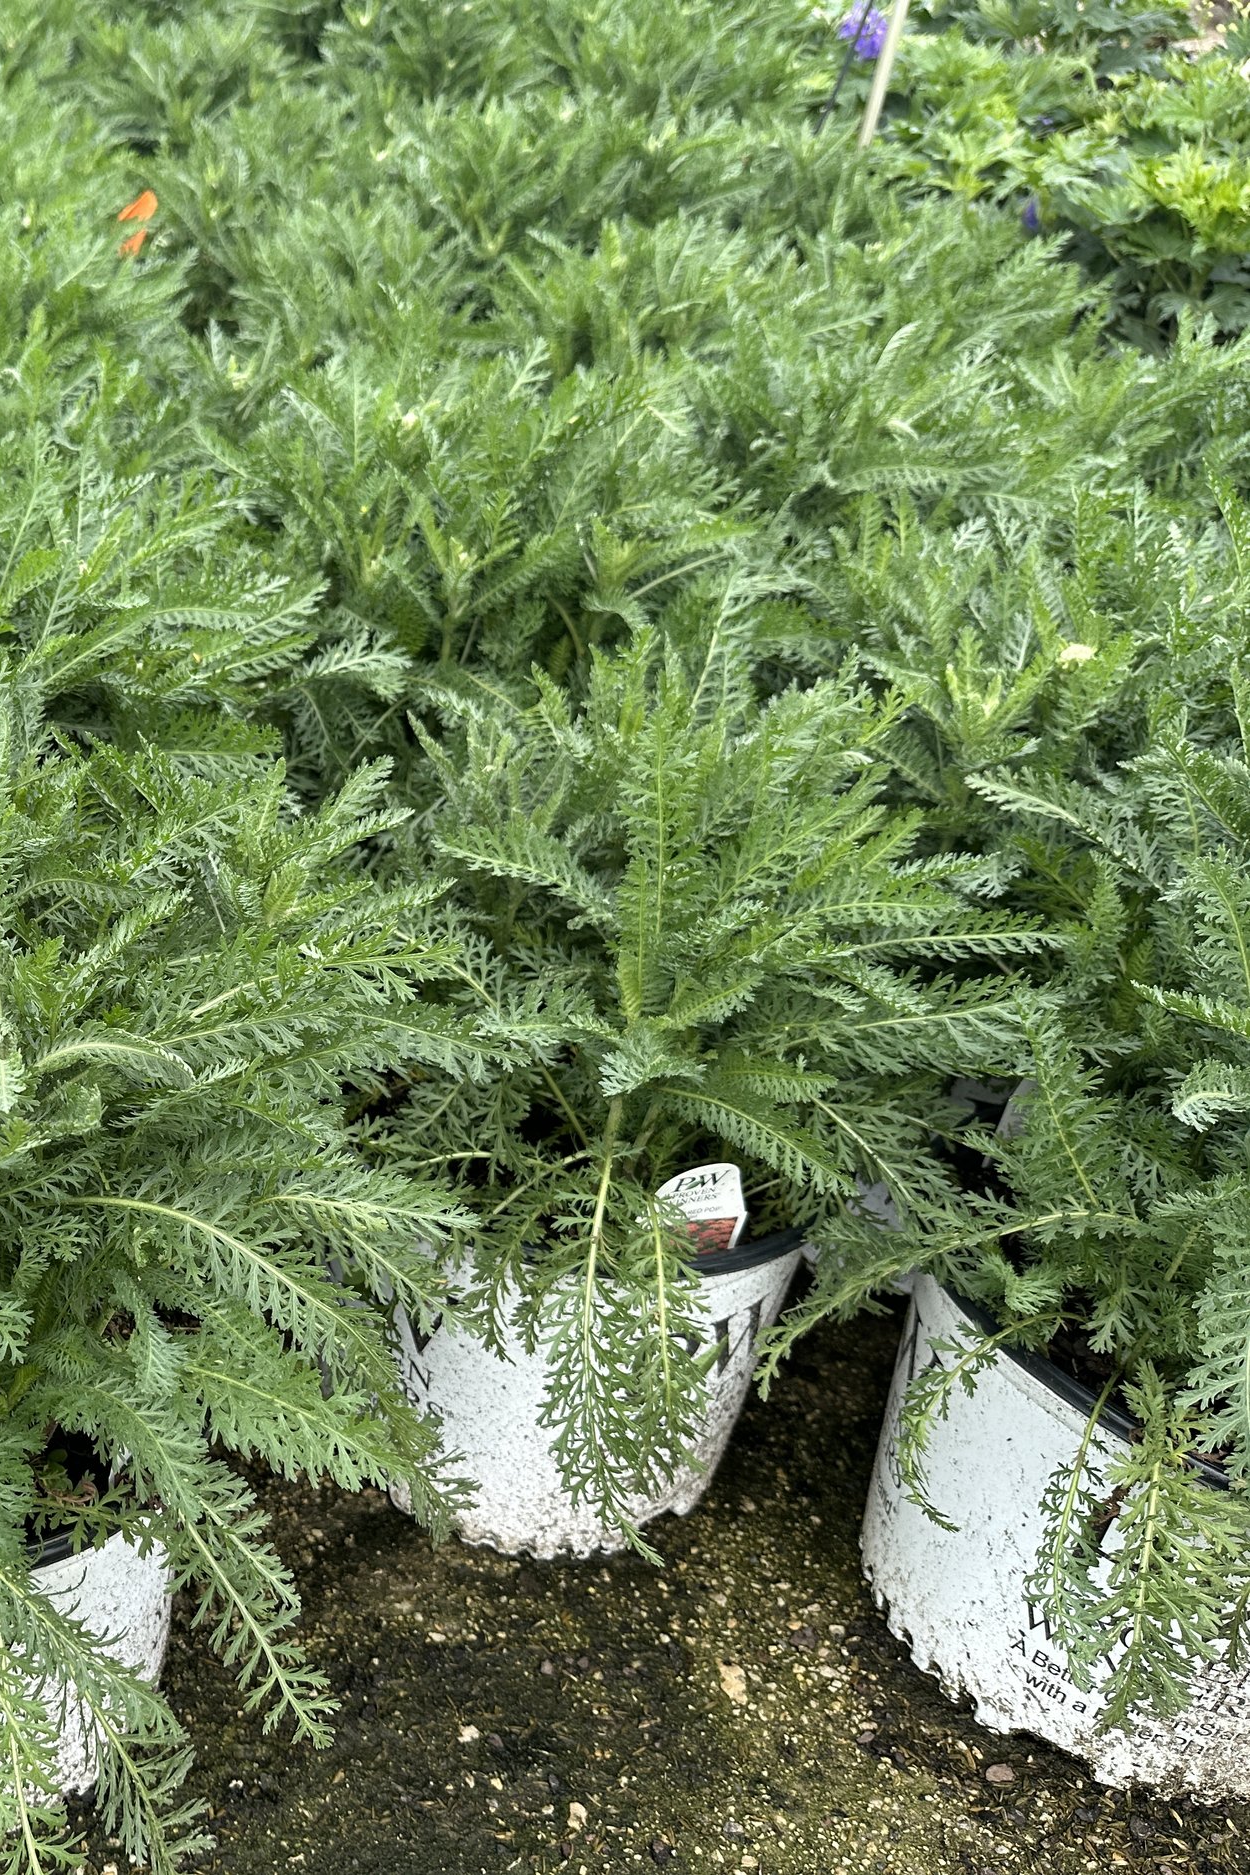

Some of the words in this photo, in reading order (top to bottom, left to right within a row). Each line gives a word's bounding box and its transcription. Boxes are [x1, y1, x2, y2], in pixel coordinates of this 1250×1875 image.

[670, 1169, 731, 1192] PW
[672, 1187, 717, 1199] PROVEN
[1011, 1634, 1026, 1657] A
[1025, 1671, 1068, 1704] with
[1072, 1703, 1087, 1714] a
